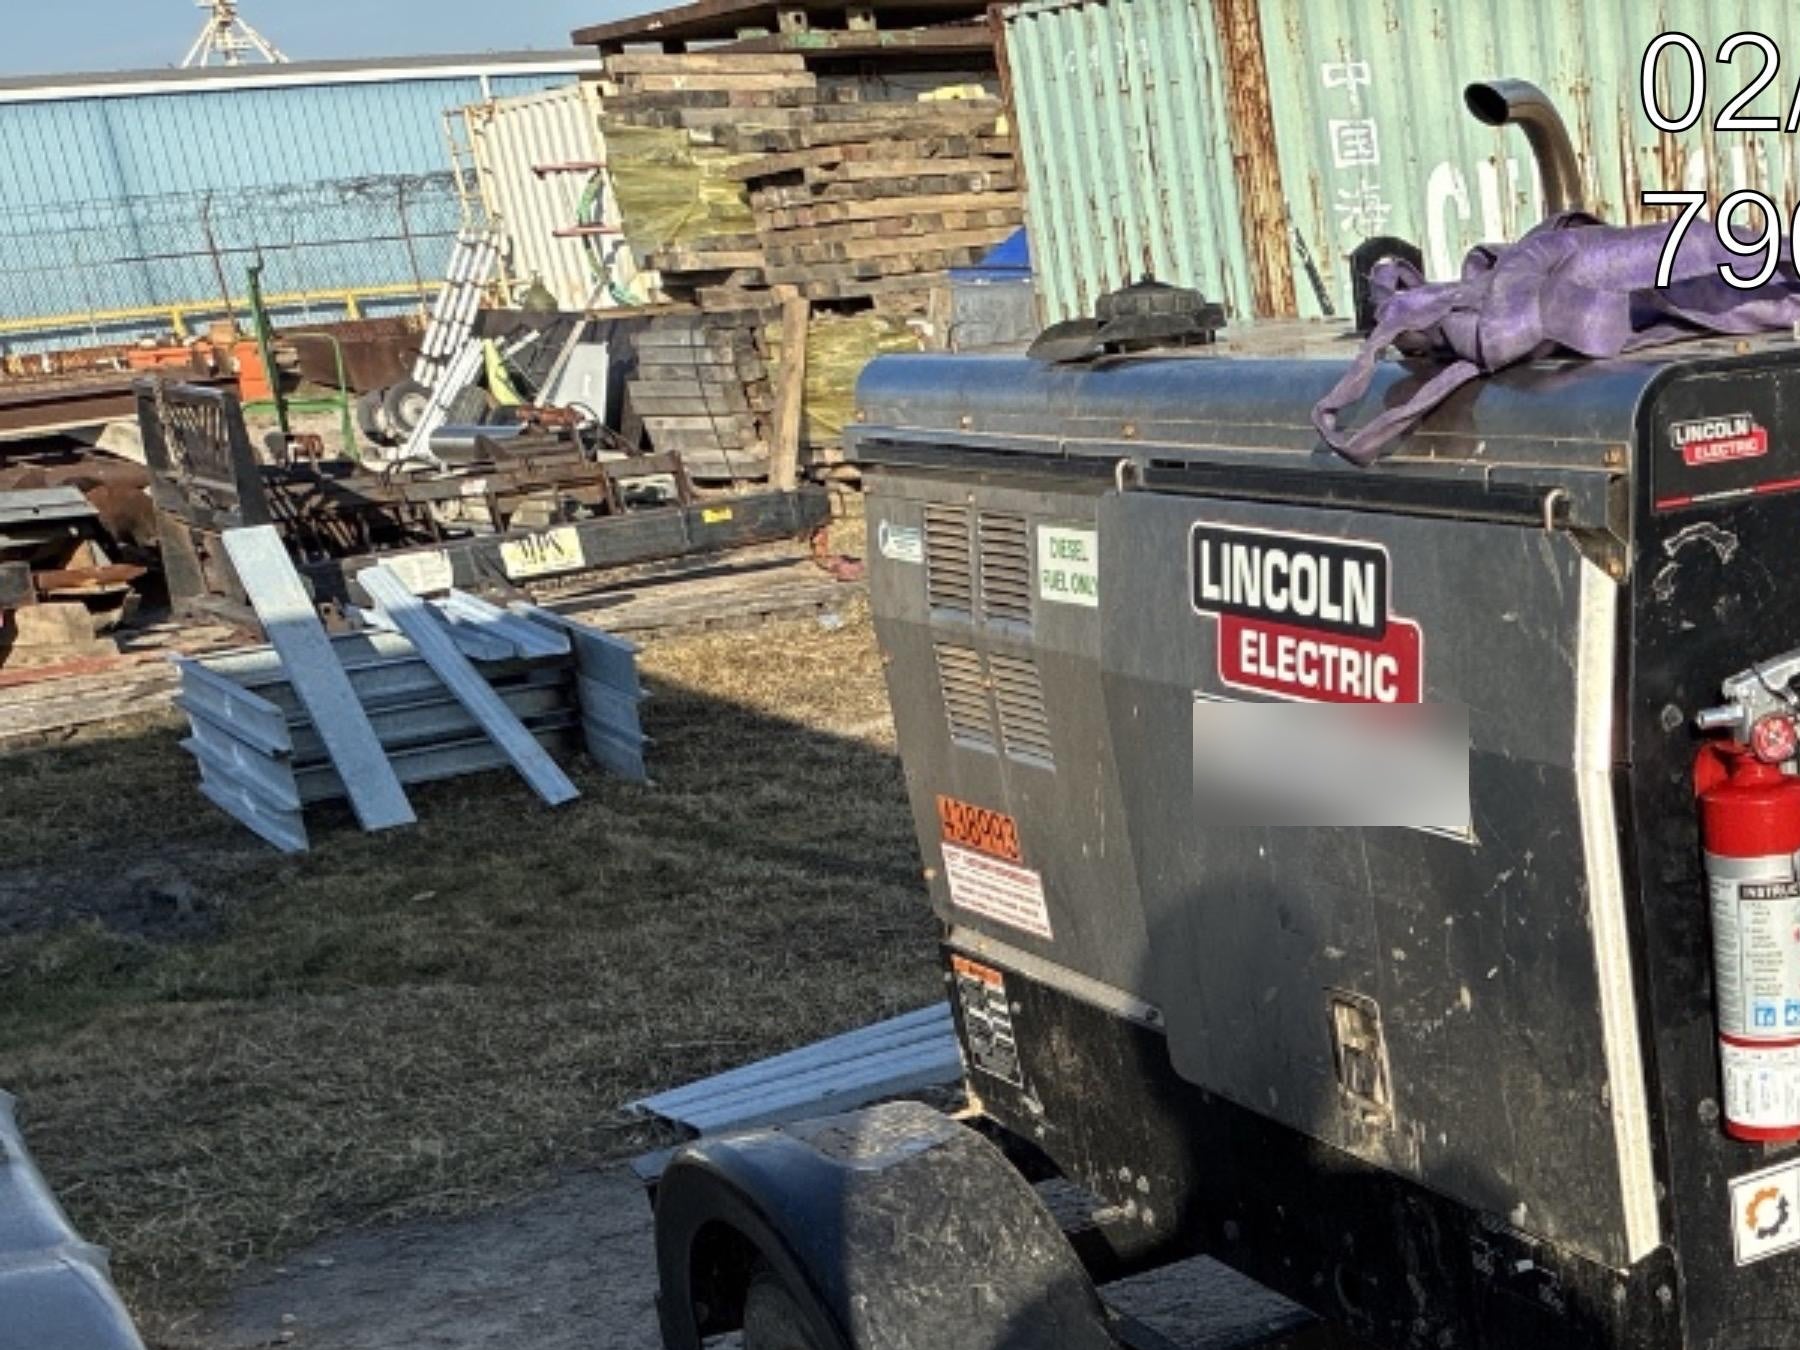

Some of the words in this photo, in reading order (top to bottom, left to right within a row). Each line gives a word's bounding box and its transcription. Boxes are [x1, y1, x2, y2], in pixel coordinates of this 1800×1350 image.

[1676, 418, 1750, 445] LINCOLN
[1694, 437, 1759, 459] ELECTRIC
[1049, 536, 1089, 562] DIESEL
[1042, 568, 1069, 592] FUEL
[1199, 538, 1377, 628] LINCOLN
[1240, 628, 1399, 703] ELECTRIC
